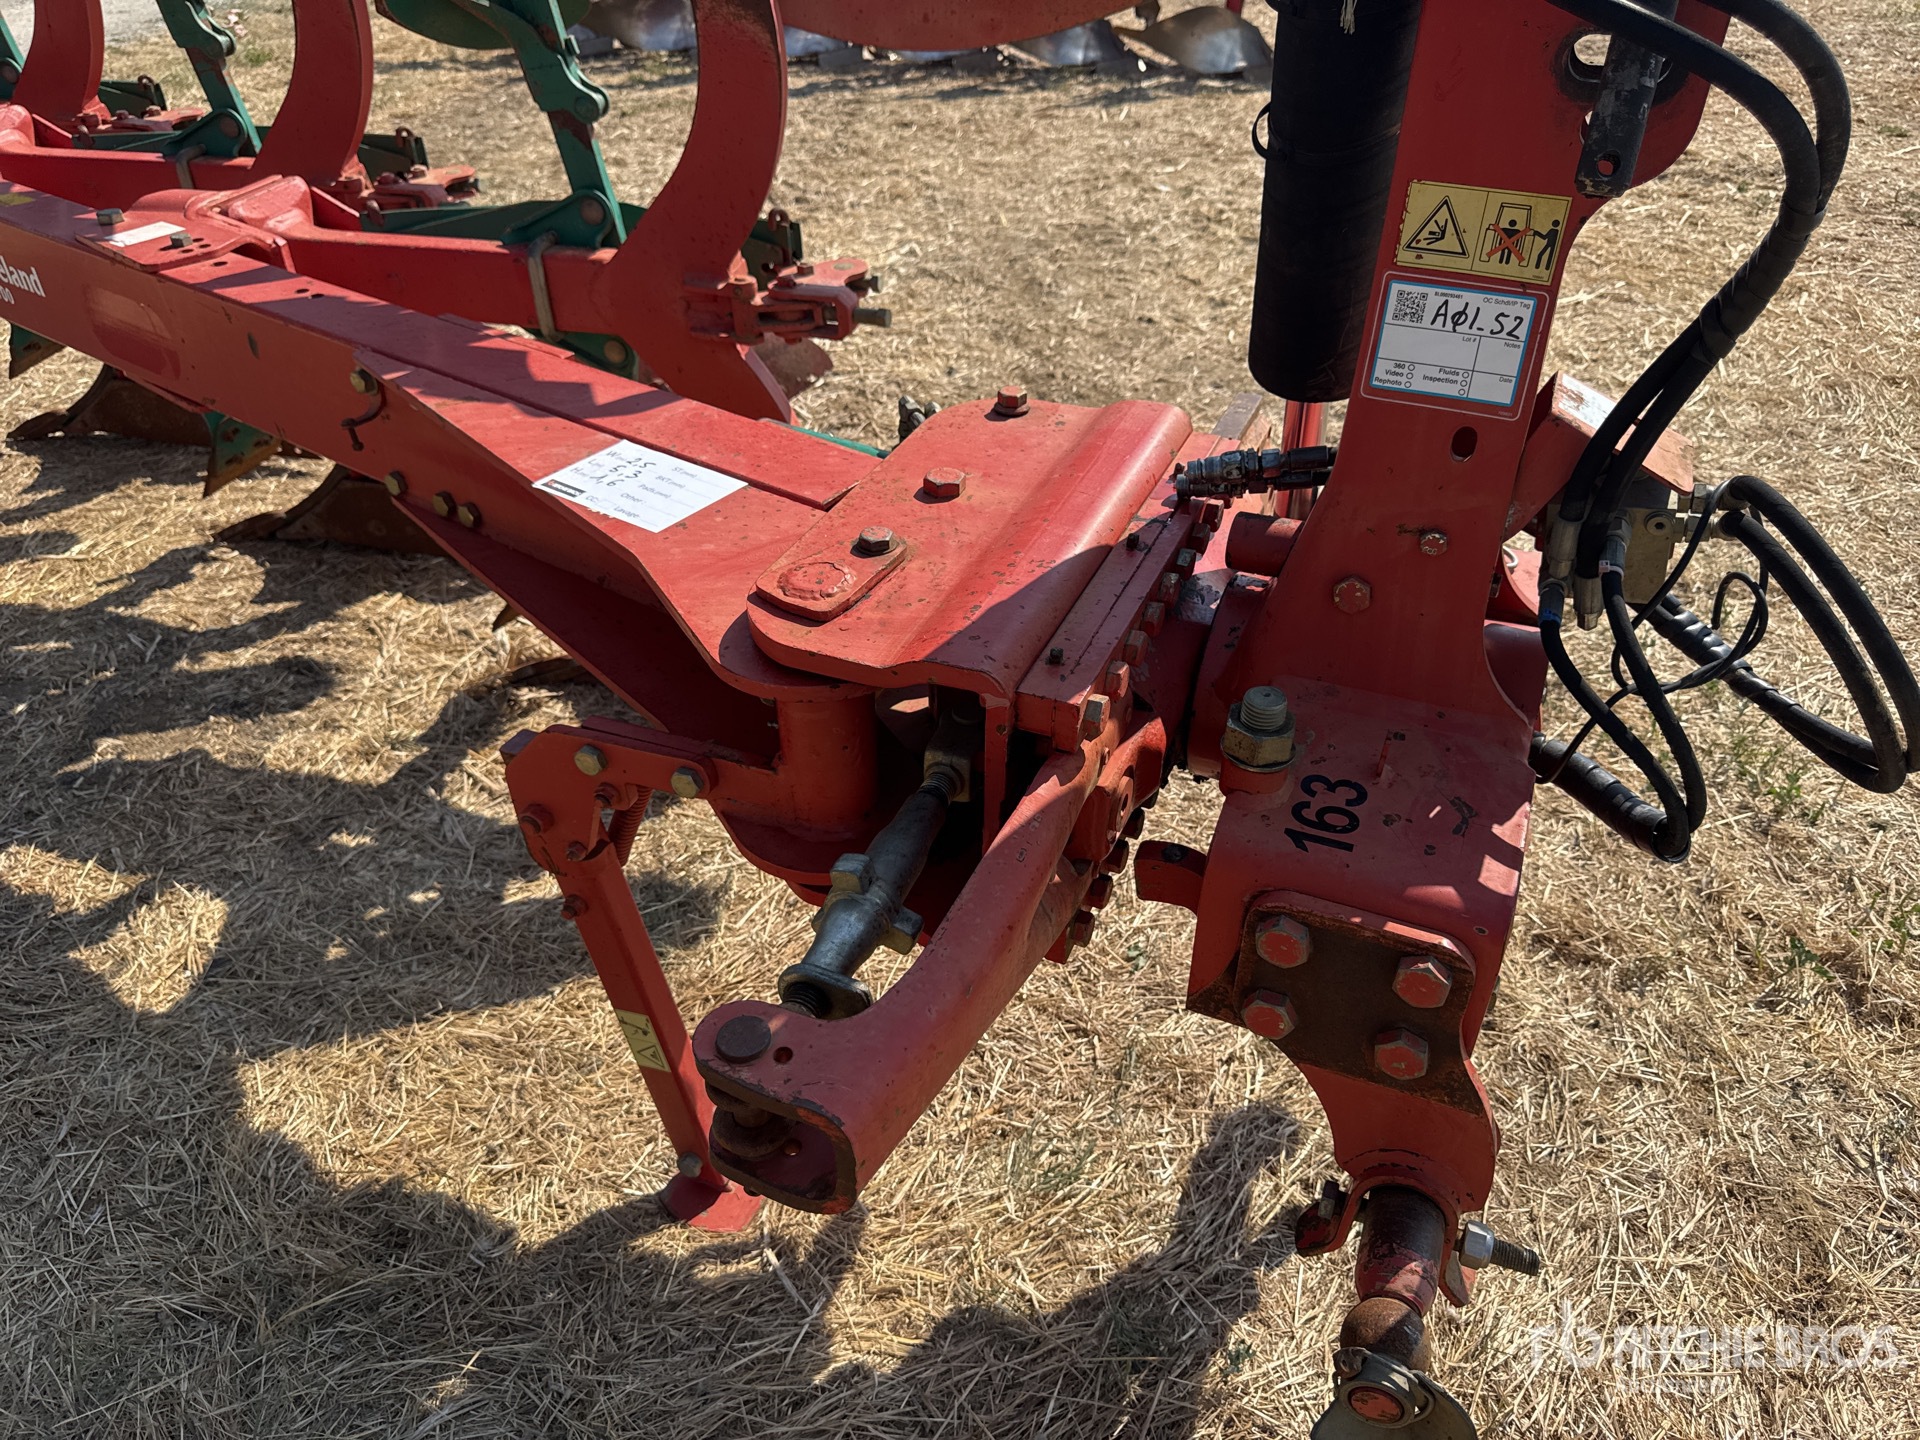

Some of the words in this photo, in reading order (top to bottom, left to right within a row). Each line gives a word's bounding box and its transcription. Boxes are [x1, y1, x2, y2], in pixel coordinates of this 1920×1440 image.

[1519, 300, 1531, 309] Tag
[1503, 341, 1521, 349] Notes
[1393, 362, 1406, 370] 360
[1384, 369, 1404, 377] Video
[1438, 368, 1460, 377] Fluids
[1374, 376, 1402, 386] Rephoto
[1422, 374, 1458, 385] Inspection
[1498, 376, 1513, 384] Date
[1284, 775, 1368, 853] 163
